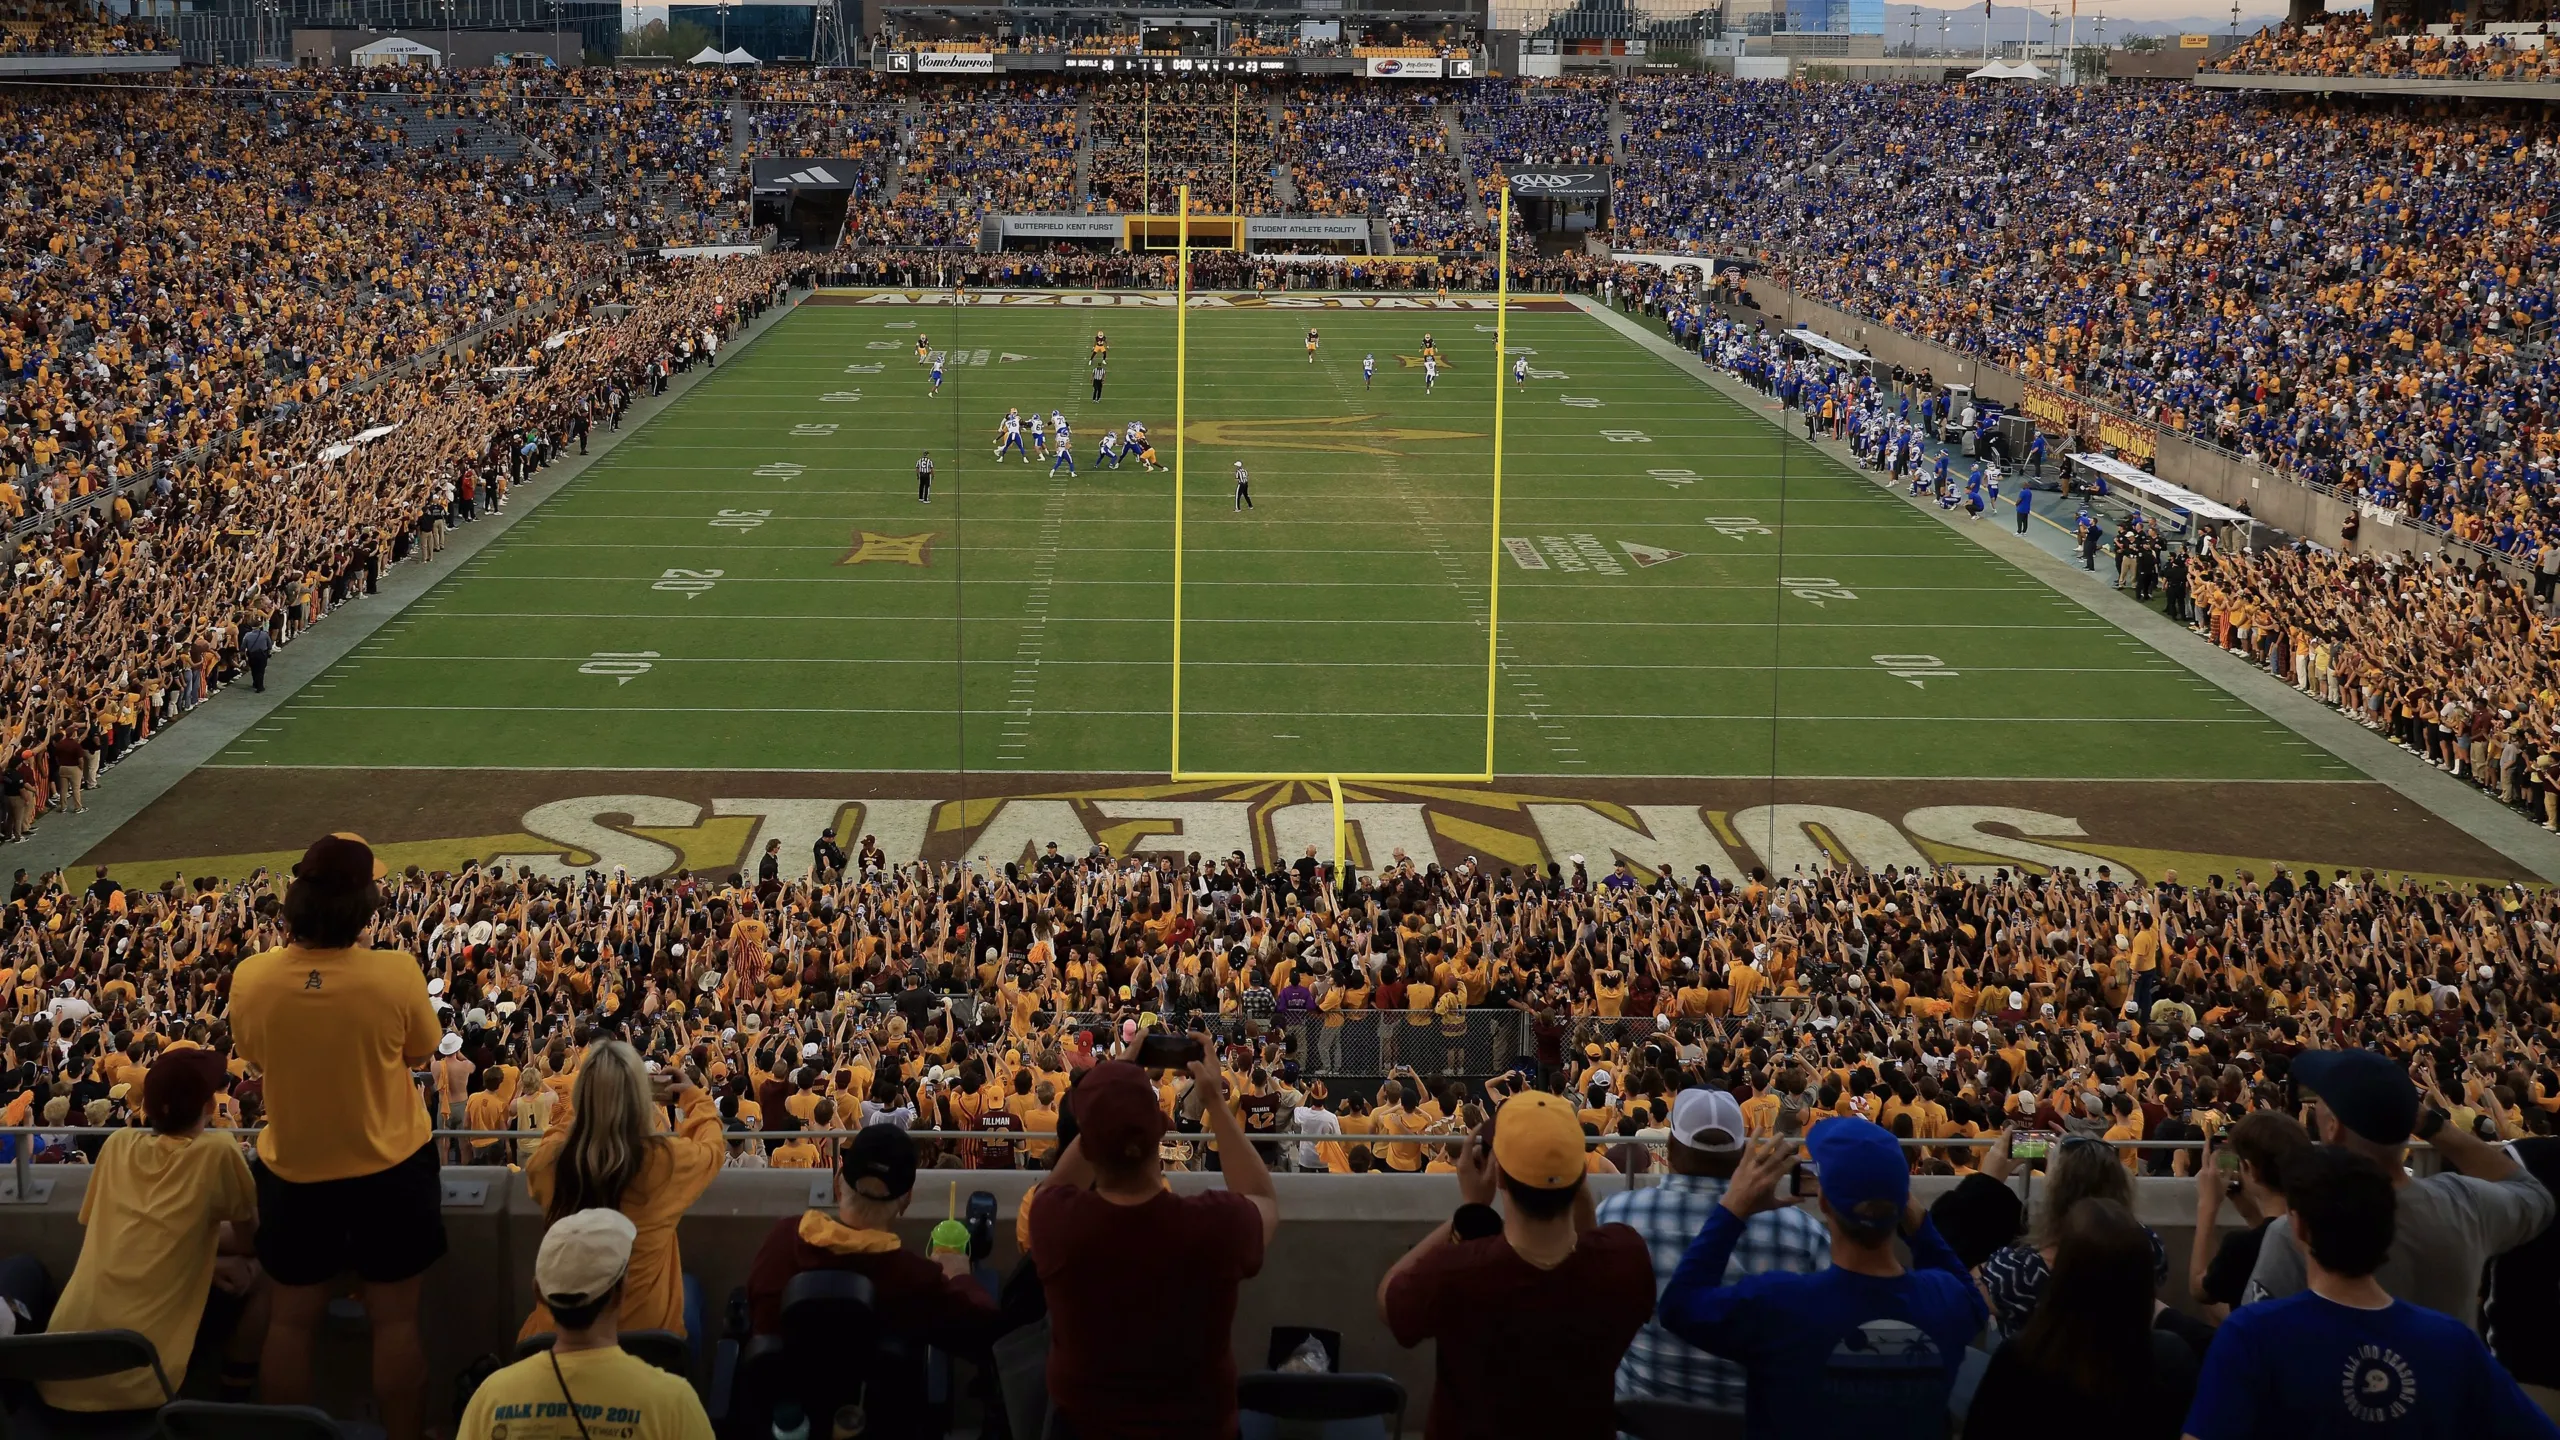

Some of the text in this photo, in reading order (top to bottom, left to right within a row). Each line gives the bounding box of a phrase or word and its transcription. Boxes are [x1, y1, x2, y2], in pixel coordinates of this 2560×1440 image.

[894, 56, 907, 69] 19
[918, 54, 993, 68] Someburros
[1065, 59, 1077, 67] SUN
[1078, 59, 1099, 67] DEVILS
[1173, 59, 1192, 71] 0:00
[1457, 62, 1470, 75] 19
[1014, 222, 1064, 230] BUTTERFIELD
[1087, 223, 1114, 231] FURST
[1252, 225, 1287, 233] STUDENT
[1323, 226, 1357, 234] FACILITY
[856, 293, 1528, 309] ARIZONA STATE
[788, 423, 840, 436] 50
[1007, 421, 1017, 429] 76
[1599, 429, 1653, 443] 50
[2100, 424, 2128, 451] HONOR
[2131, 437, 2153, 458] ROW
[752, 462, 807, 476] 40
[1646, 469, 1703, 484] 40
[708, 509, 773, 527] 30
[1703, 516, 1773, 536] 30
[1536, 535, 1590, 573] AMERICA
[1567, 533, 1628, 576] MOUNTAIN
[651, 568, 725, 591] 20
[1776, 577, 1860, 600] 20
[577, 650, 661, 675] 10
[1870, 653, 1960, 678] 10
[528, 1113, 537, 1129] 1
[982, 1116, 1010, 1126] TILLMAN
[1248, 1112, 1275, 1129] 42
[2383, 1348, 2417, 1404] SEASONS
[495, 1403, 532, 1421] WALK
[535, 1402, 569, 1419] FOR
[605, 1407, 642, 1424] 2011
